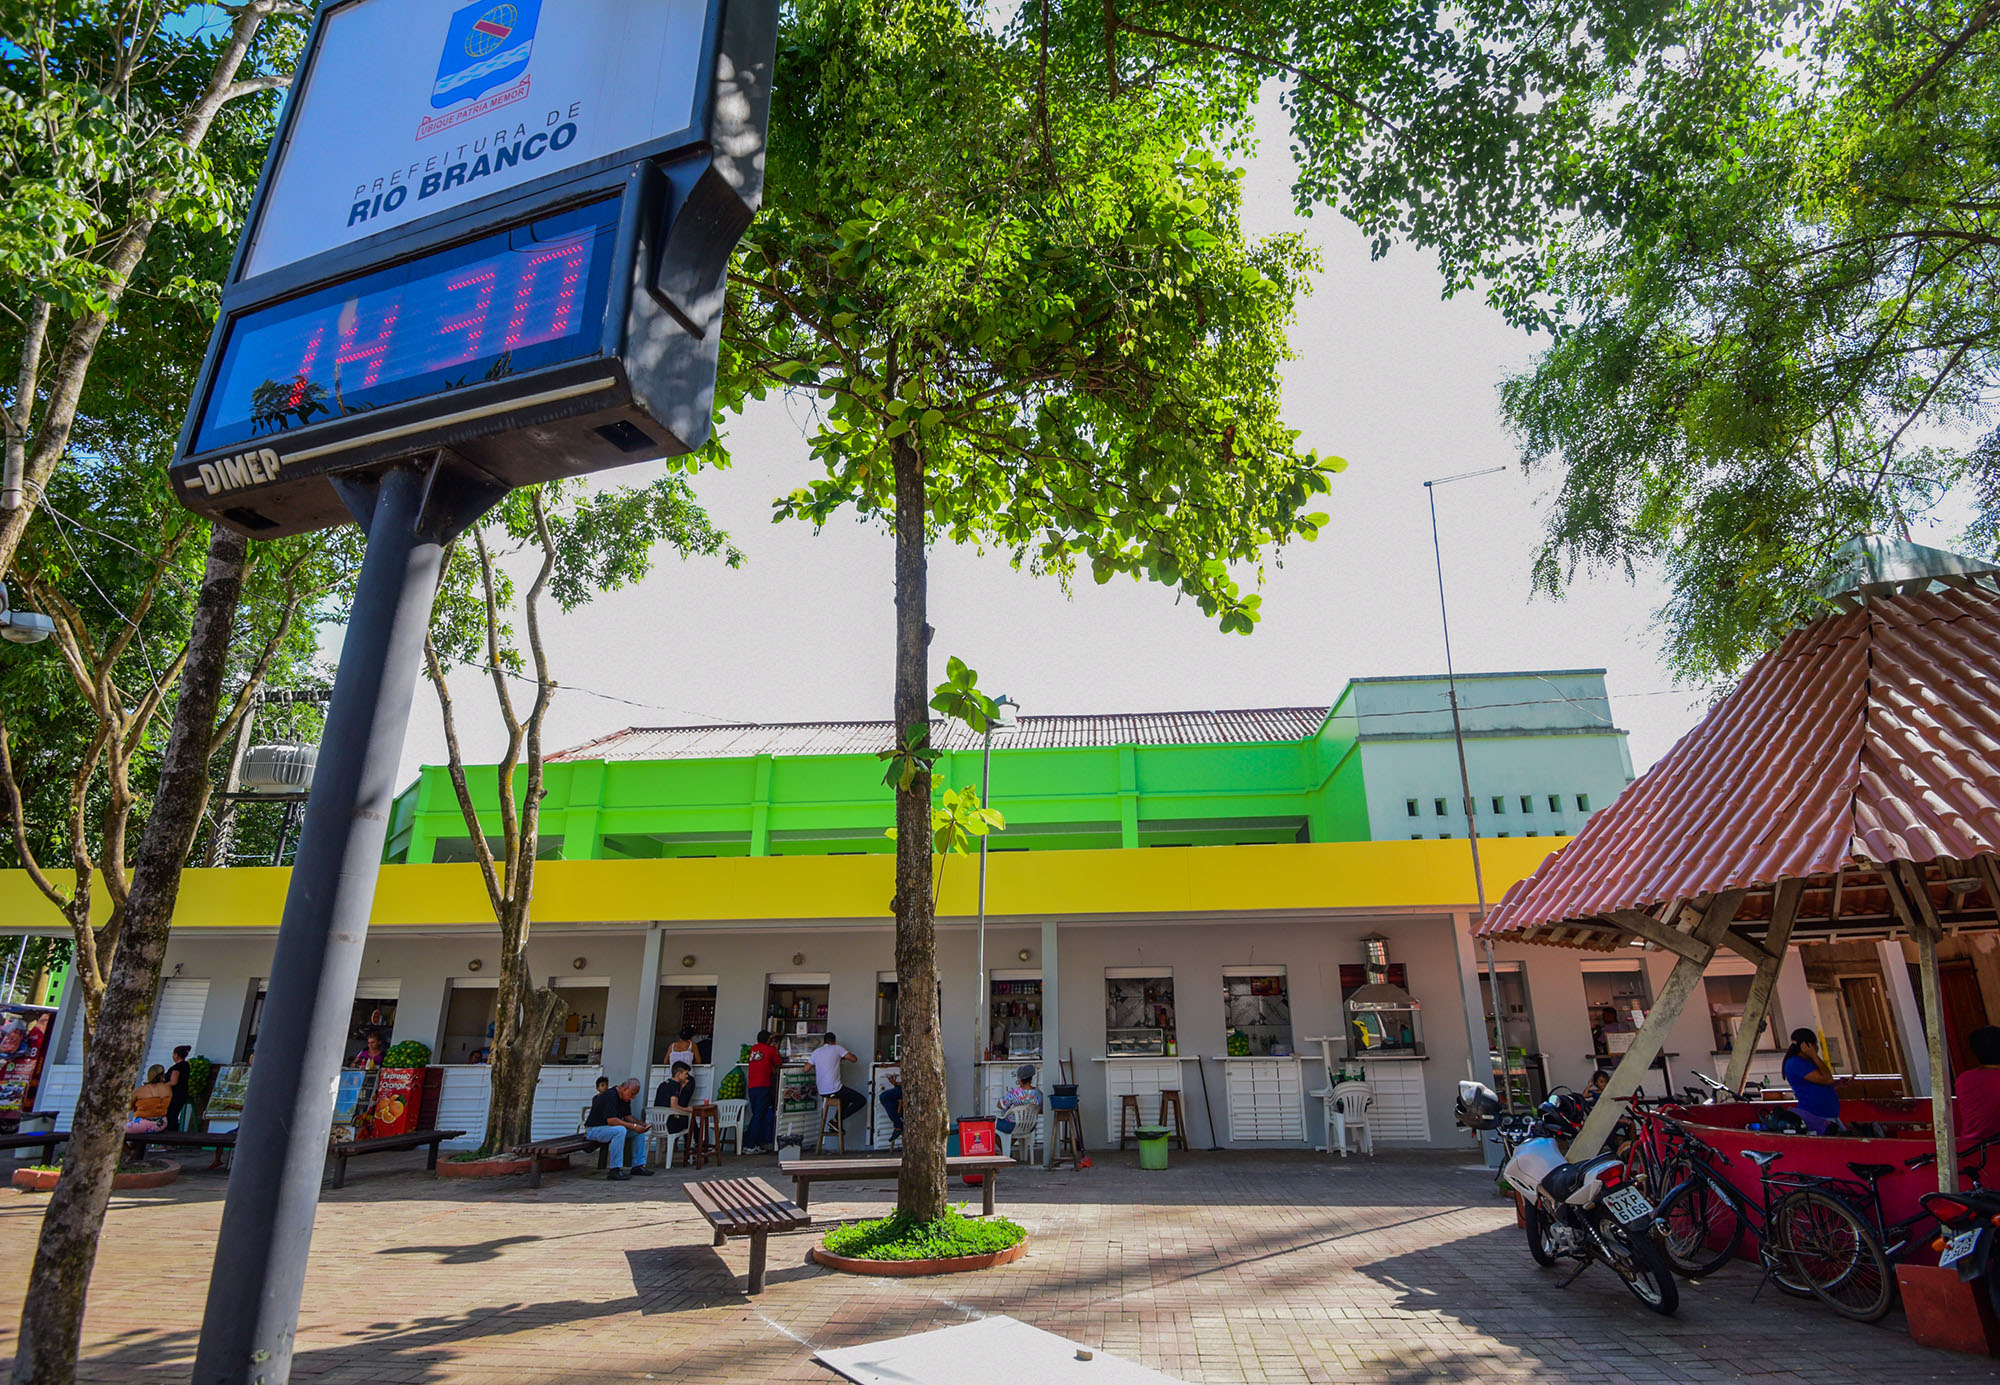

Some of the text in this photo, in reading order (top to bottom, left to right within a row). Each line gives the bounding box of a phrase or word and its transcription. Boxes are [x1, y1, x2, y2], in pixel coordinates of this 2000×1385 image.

[421, 87, 525, 135] UBIQUE PATRIA MEMOR
[346, 121, 578, 228] RIO BRANCO
[354, 101, 581, 200] PREFEITURA DE
[198, 448, 281, 496] DIMEP
[1619, 1203, 1649, 1221] 6169
